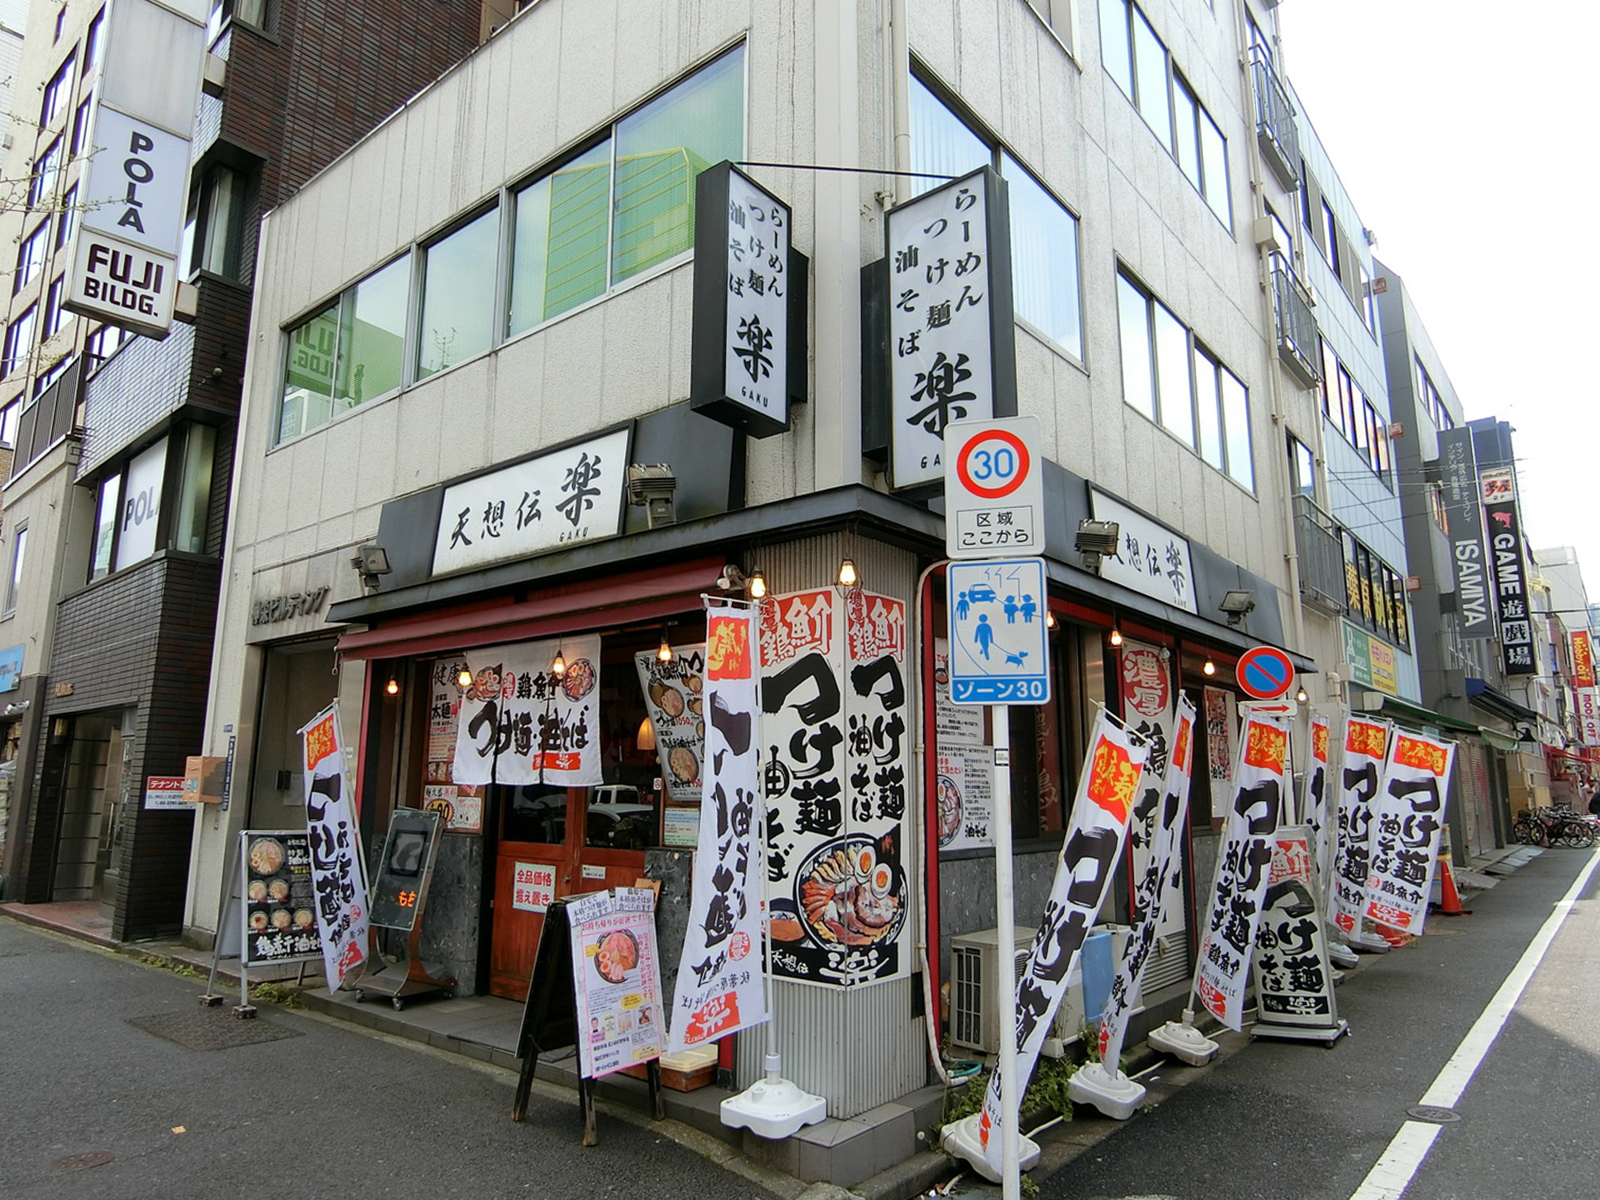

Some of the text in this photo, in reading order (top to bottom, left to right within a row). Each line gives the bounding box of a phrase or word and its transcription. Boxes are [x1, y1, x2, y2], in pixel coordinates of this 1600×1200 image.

[117, 131, 154, 234] POLA
[87, 243, 164, 294] FUJI
[730, 201, 747, 298] 油そば
[749, 203, 765, 296] つけ麺
[769, 206, 784, 298] らーめん
[924, 218, 951, 332] つけ麺
[955, 188, 984, 312] らーめん
[83, 276, 159, 317] BILDG.
[895, 244, 921, 357] 油そば
[732, 314, 774, 384] 楽
[741, 386, 769, 408] GAKU
[906, 352, 977, 441] 楽
[973, 448, 1014, 480] 30
[559, 526, 589, 543] GAKU
[962, 529, 1029, 546] ここから
[977, 512, 1014, 527] 区域
[1455, 538, 1487, 628] ISAMIYA
[1494, 533, 1520, 597] GAME
[1501, 599, 1531, 666] 遊戯場
[957, 680, 1042, 699] ゾーン30
[1124, 651, 1169, 717] 濃厚
[757, 652, 843, 837] つけ麺
[849, 713, 876, 823] 油そば
[850, 655, 905, 821] つけ麺
[1222, 779, 1280, 956] つけ麺
[1371, 812, 1401, 874] 油そば
[1388, 776, 1440, 888] つけ麺
[516, 889, 551, 907] 据え置き
[517, 870, 552, 887] 全品価格
[1255, 921, 1287, 993] 油そば
[1262, 880, 1326, 993] つけ麺
